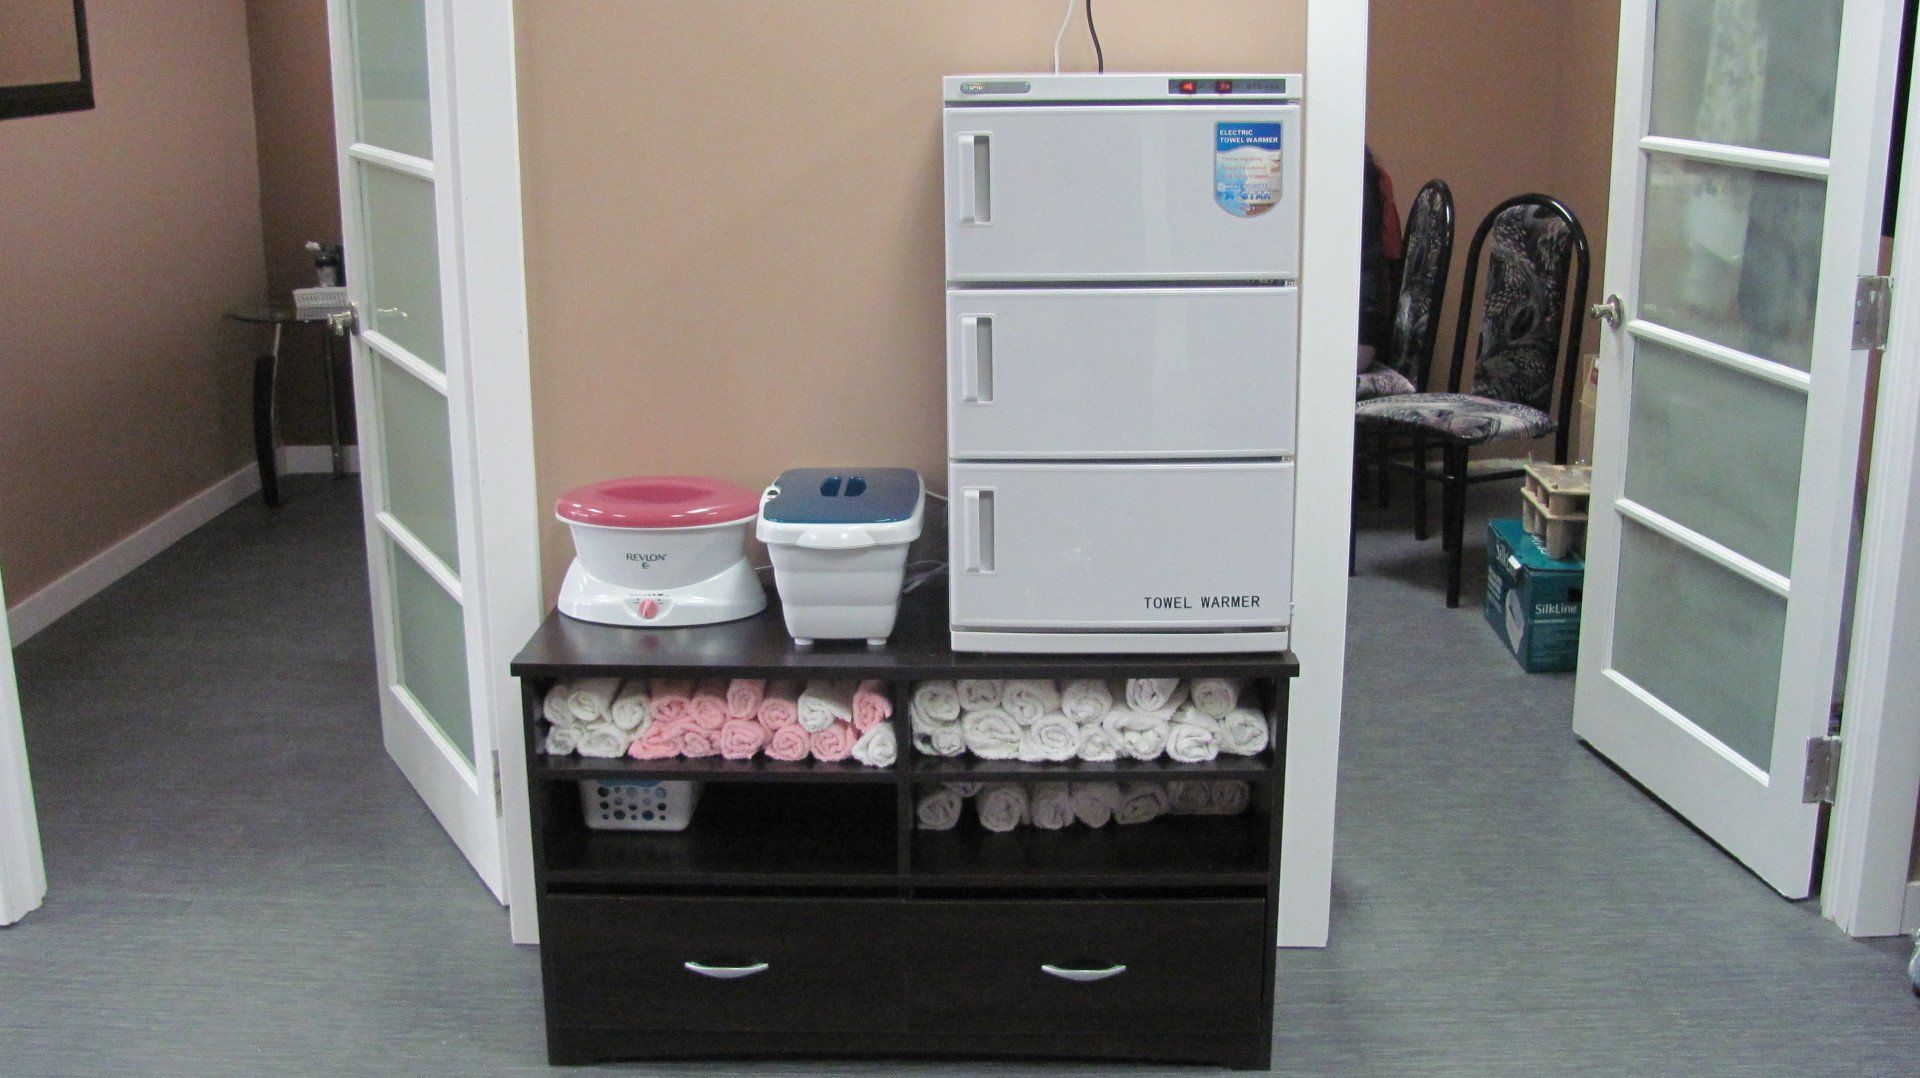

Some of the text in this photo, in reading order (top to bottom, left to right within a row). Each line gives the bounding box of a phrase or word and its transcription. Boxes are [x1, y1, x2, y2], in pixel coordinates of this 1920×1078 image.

[626, 553, 665, 561] REVLON
[1144, 595, 1261, 609] TOWEL WARMER
[1534, 603, 1578, 615] SilkLine
